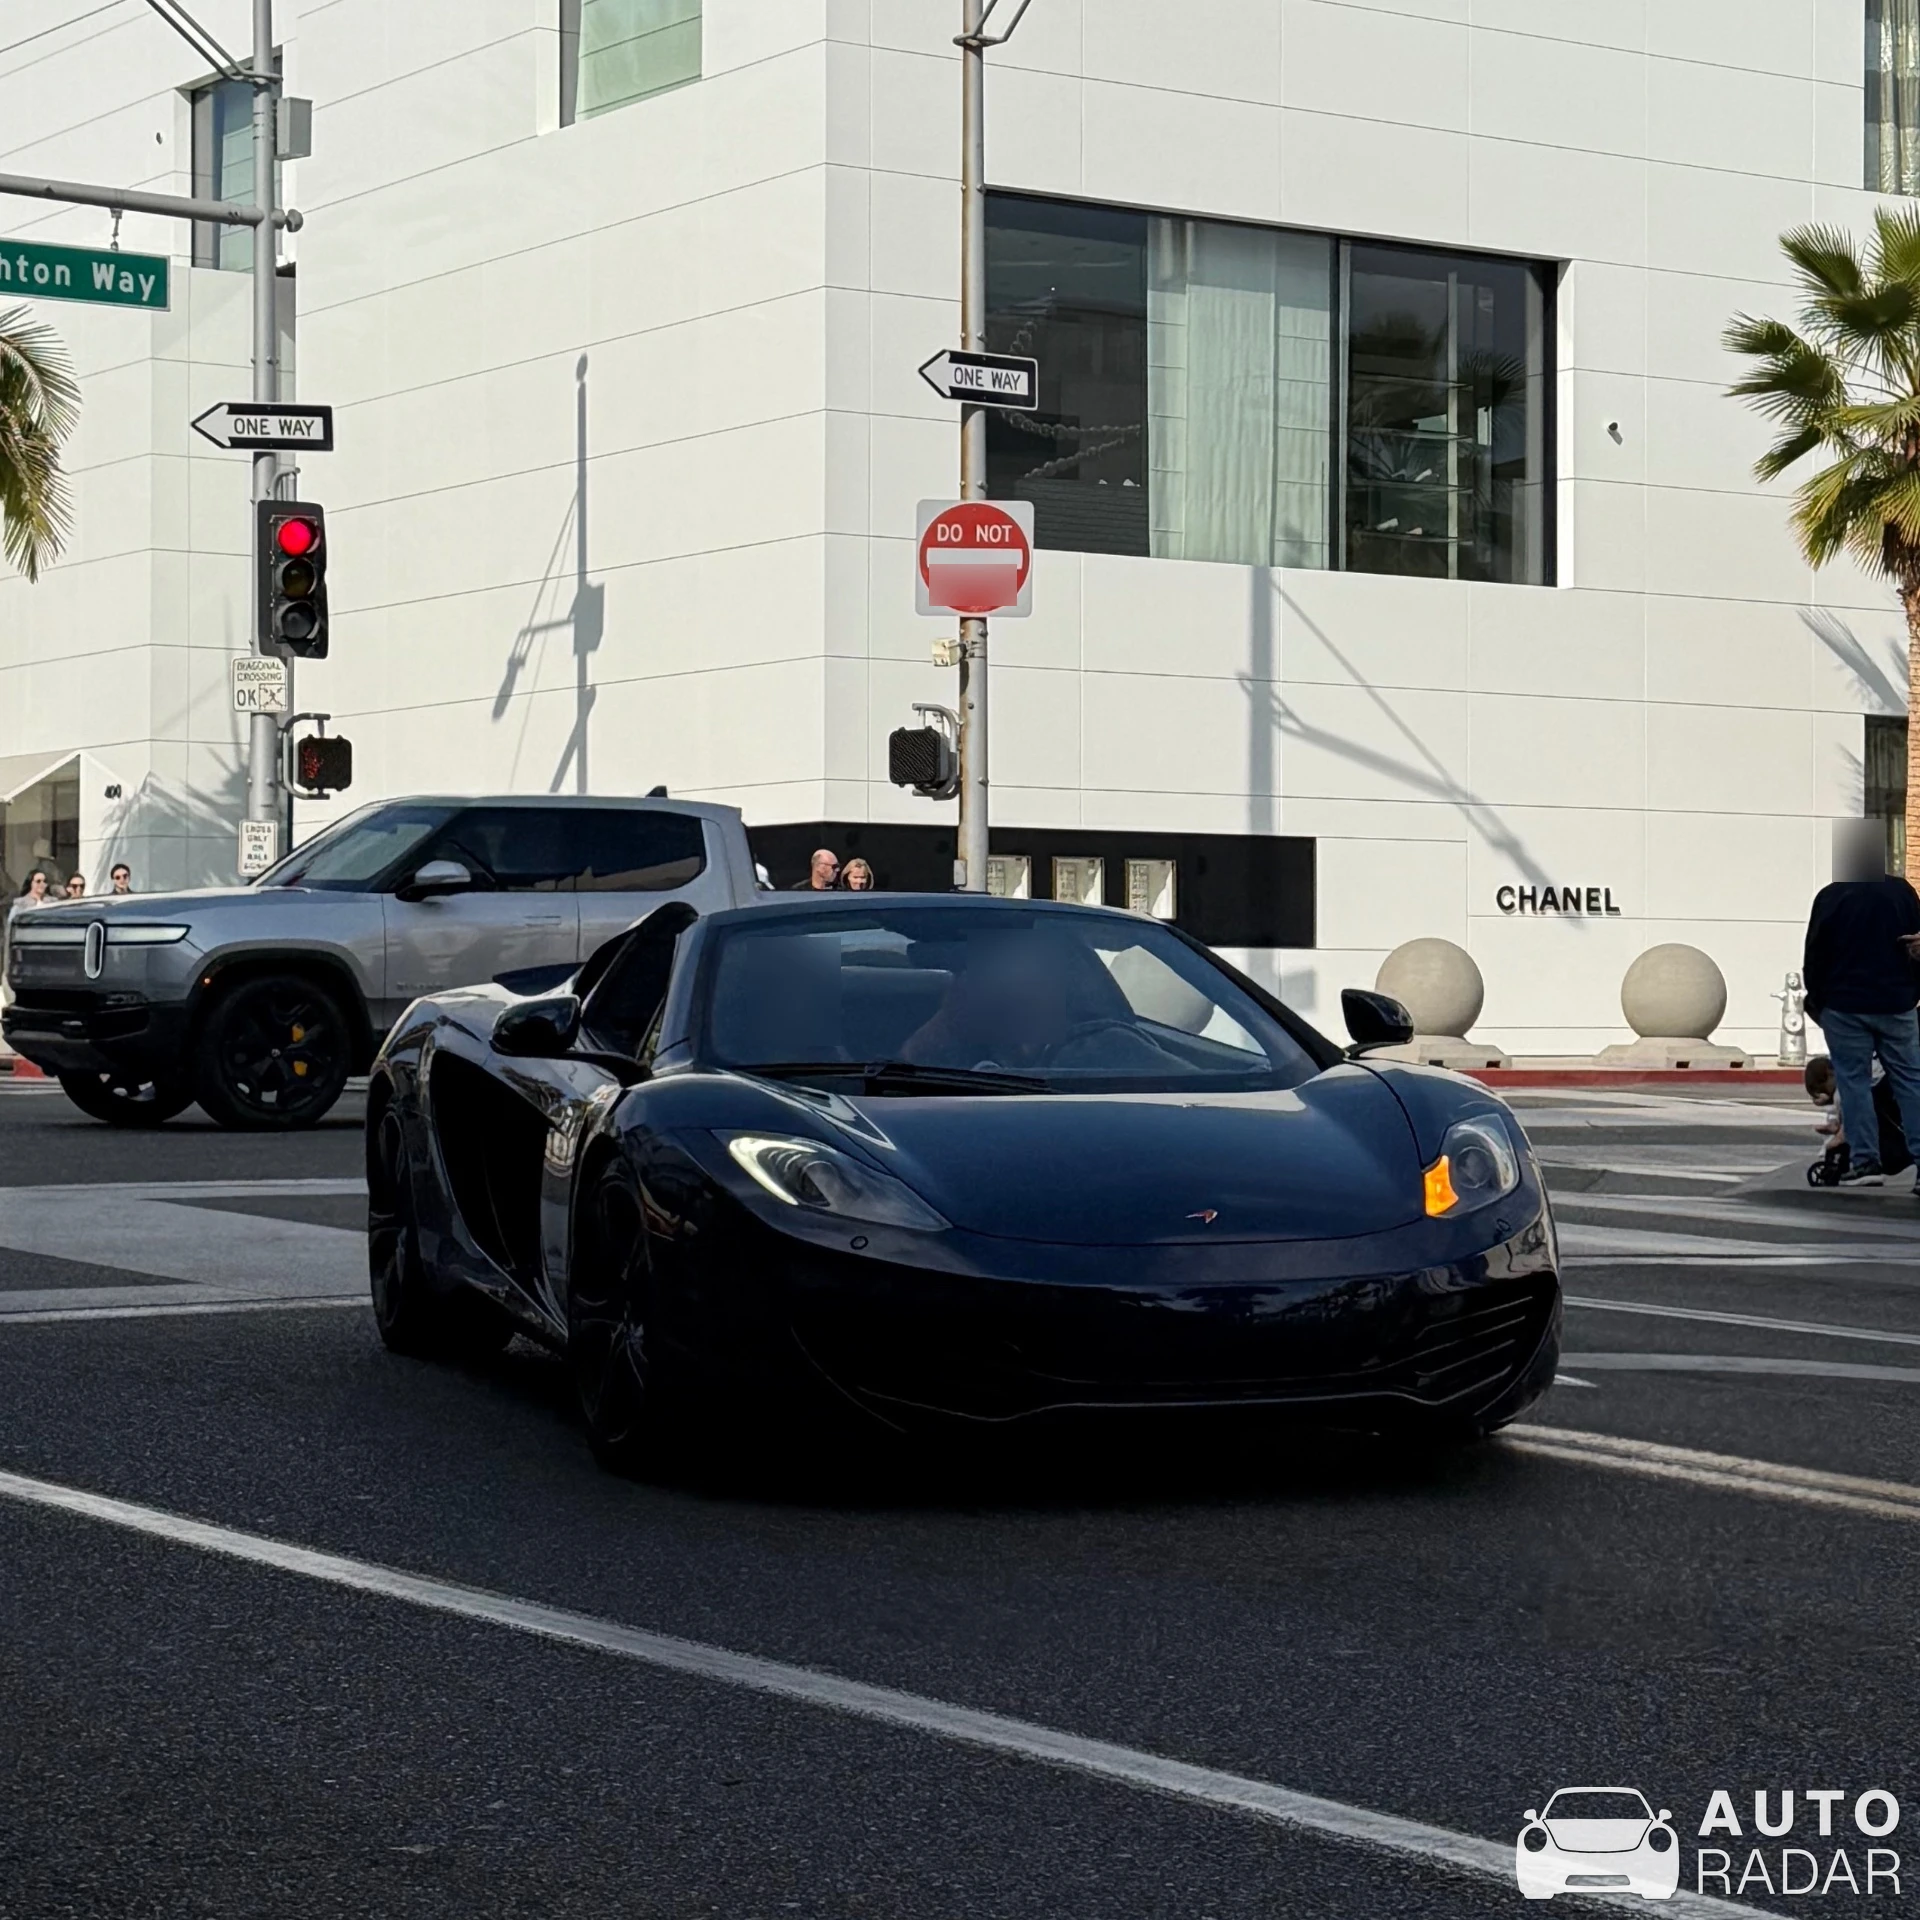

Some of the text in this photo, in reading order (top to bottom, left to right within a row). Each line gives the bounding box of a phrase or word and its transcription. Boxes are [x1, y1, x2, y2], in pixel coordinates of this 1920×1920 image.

[92, 261, 156, 302] Way
[953, 366, 1021, 391] ONE WAY
[233, 417, 315, 437] ONE WAY
[937, 523, 1013, 543] DO NOT
[236, 672, 282, 681] CROSSING
[236, 688, 257, 706] OK
[1496, 885, 1621, 914] CHANEL
